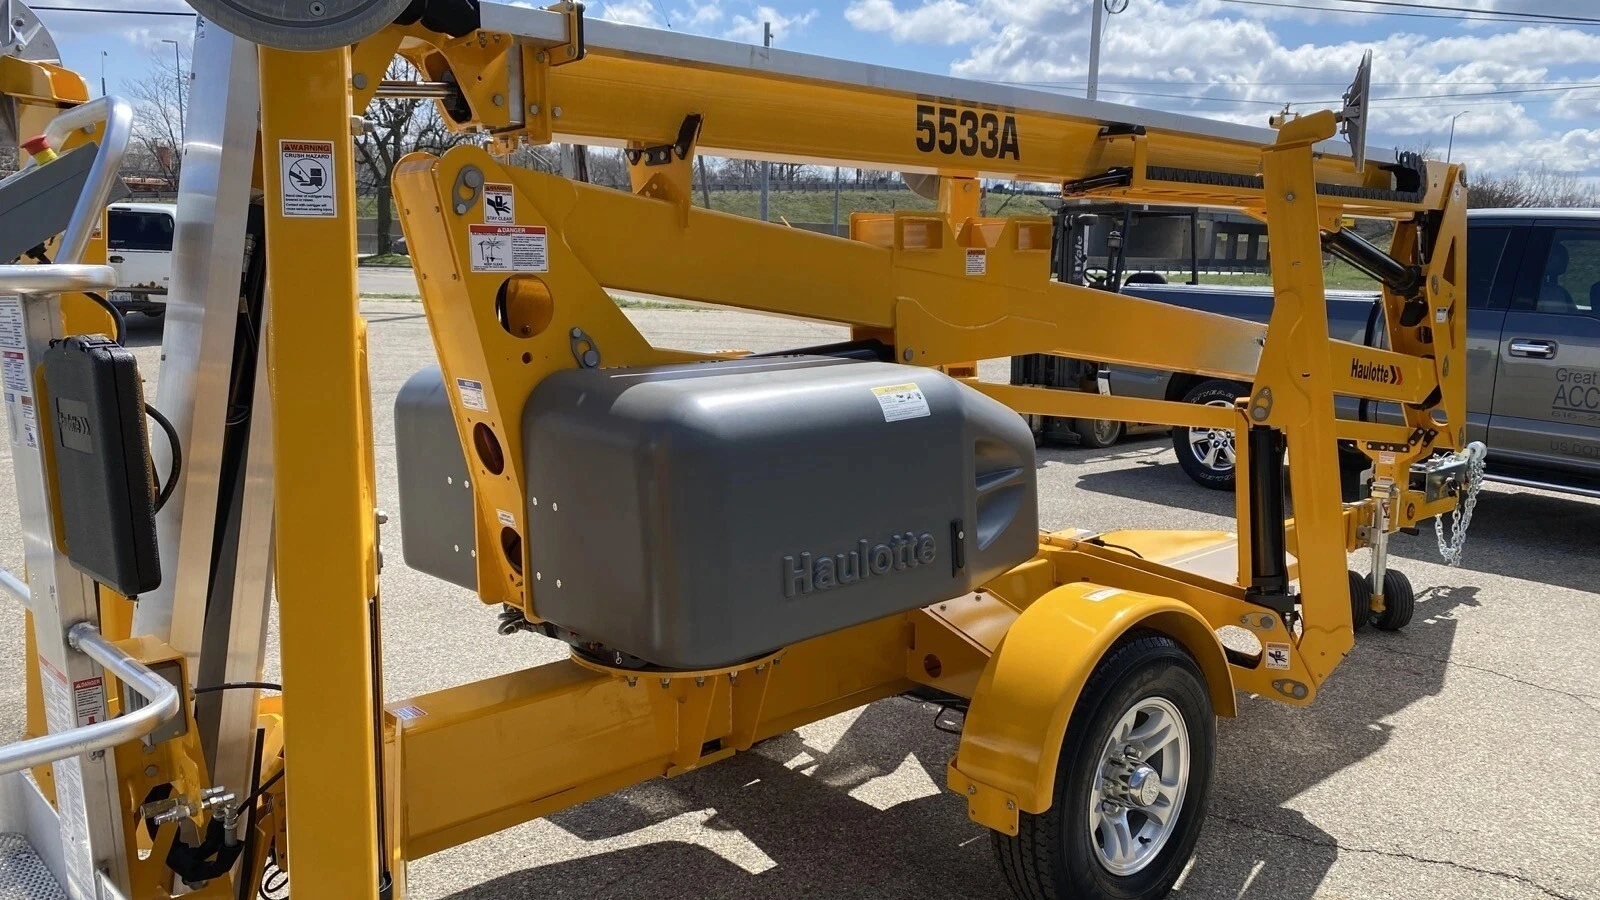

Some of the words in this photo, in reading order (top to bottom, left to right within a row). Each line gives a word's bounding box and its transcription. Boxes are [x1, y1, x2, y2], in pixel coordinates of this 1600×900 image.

[916, 104, 1020, 161] 5533A
[290, 144, 330, 152] WARNING
[1075, 235, 1083, 266] Yale
[1351, 358, 1389, 383] Haulotte
[1556, 368, 1598, 385] Great
[1552, 384, 1600, 409] ACC
[1550, 441, 1568, 451] US
[782, 532, 936, 599] Haulotte
